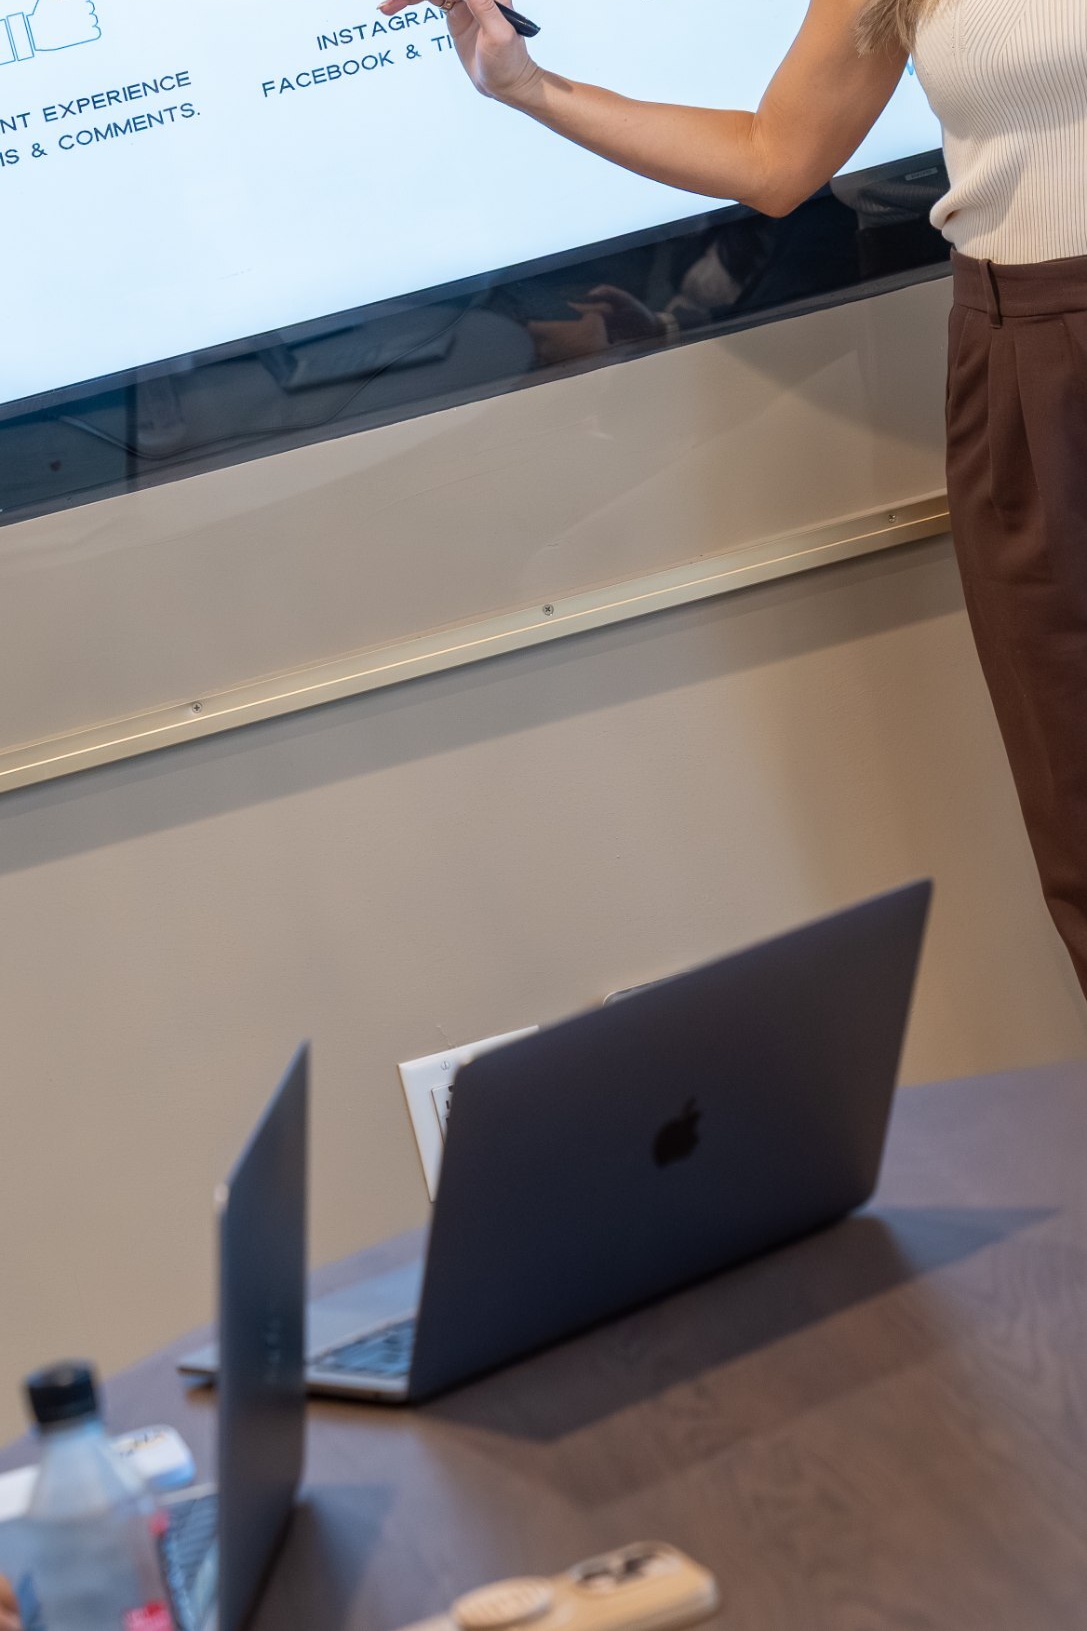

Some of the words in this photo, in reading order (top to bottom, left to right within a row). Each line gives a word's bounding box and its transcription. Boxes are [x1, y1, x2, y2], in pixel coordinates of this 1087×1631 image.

[42, 70, 192, 122] EXPERIENCE
[262, 50, 395, 98] FACEBOOK
[406, 44, 422, 60] &
[31, 142, 48, 158] &
[58, 102, 201, 150] COMMENTS.
